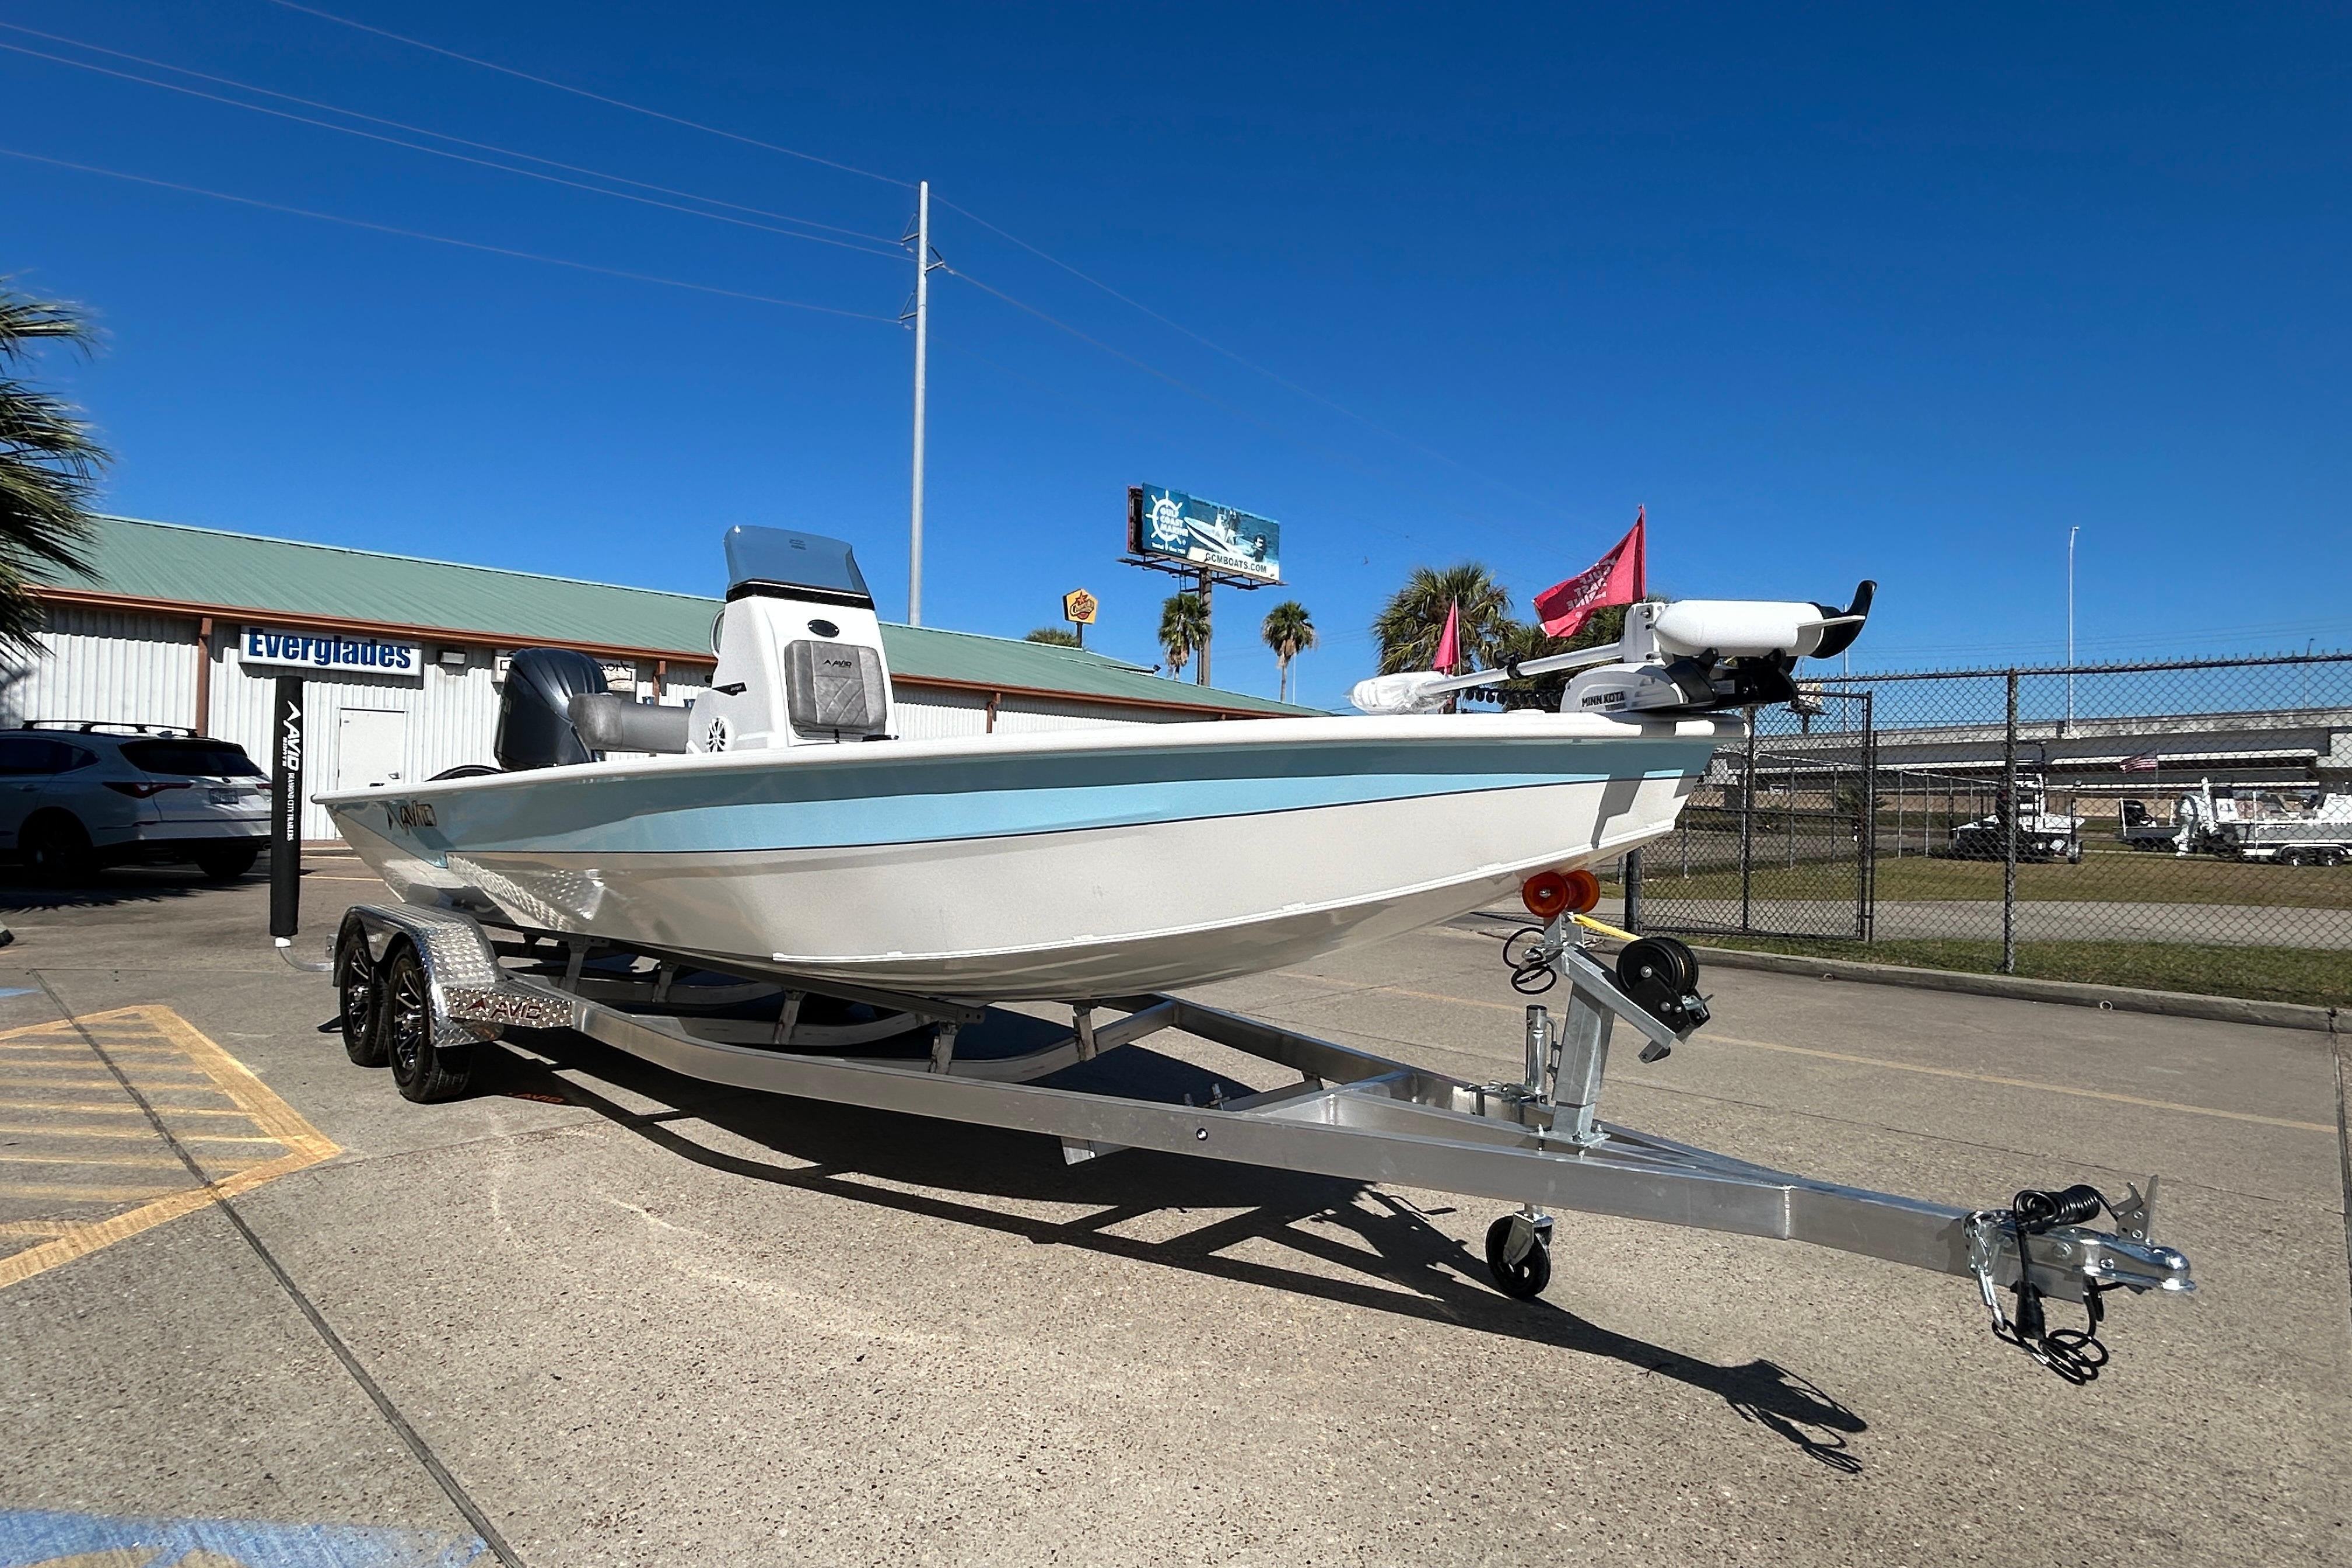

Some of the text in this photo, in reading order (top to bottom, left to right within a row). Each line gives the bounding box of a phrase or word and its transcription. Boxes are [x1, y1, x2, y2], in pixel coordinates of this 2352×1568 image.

[1160, 516, 1184, 528] COAST
[1160, 523, 1189, 537] MARINE
[1205, 552, 1267, 573] GCMBOATS.COM
[249, 628, 411, 668] Everglades
[1582, 694, 1602, 708] MINN
[1603, 691, 1626, 704] KOTA
[282, 720, 301, 771] AVID
